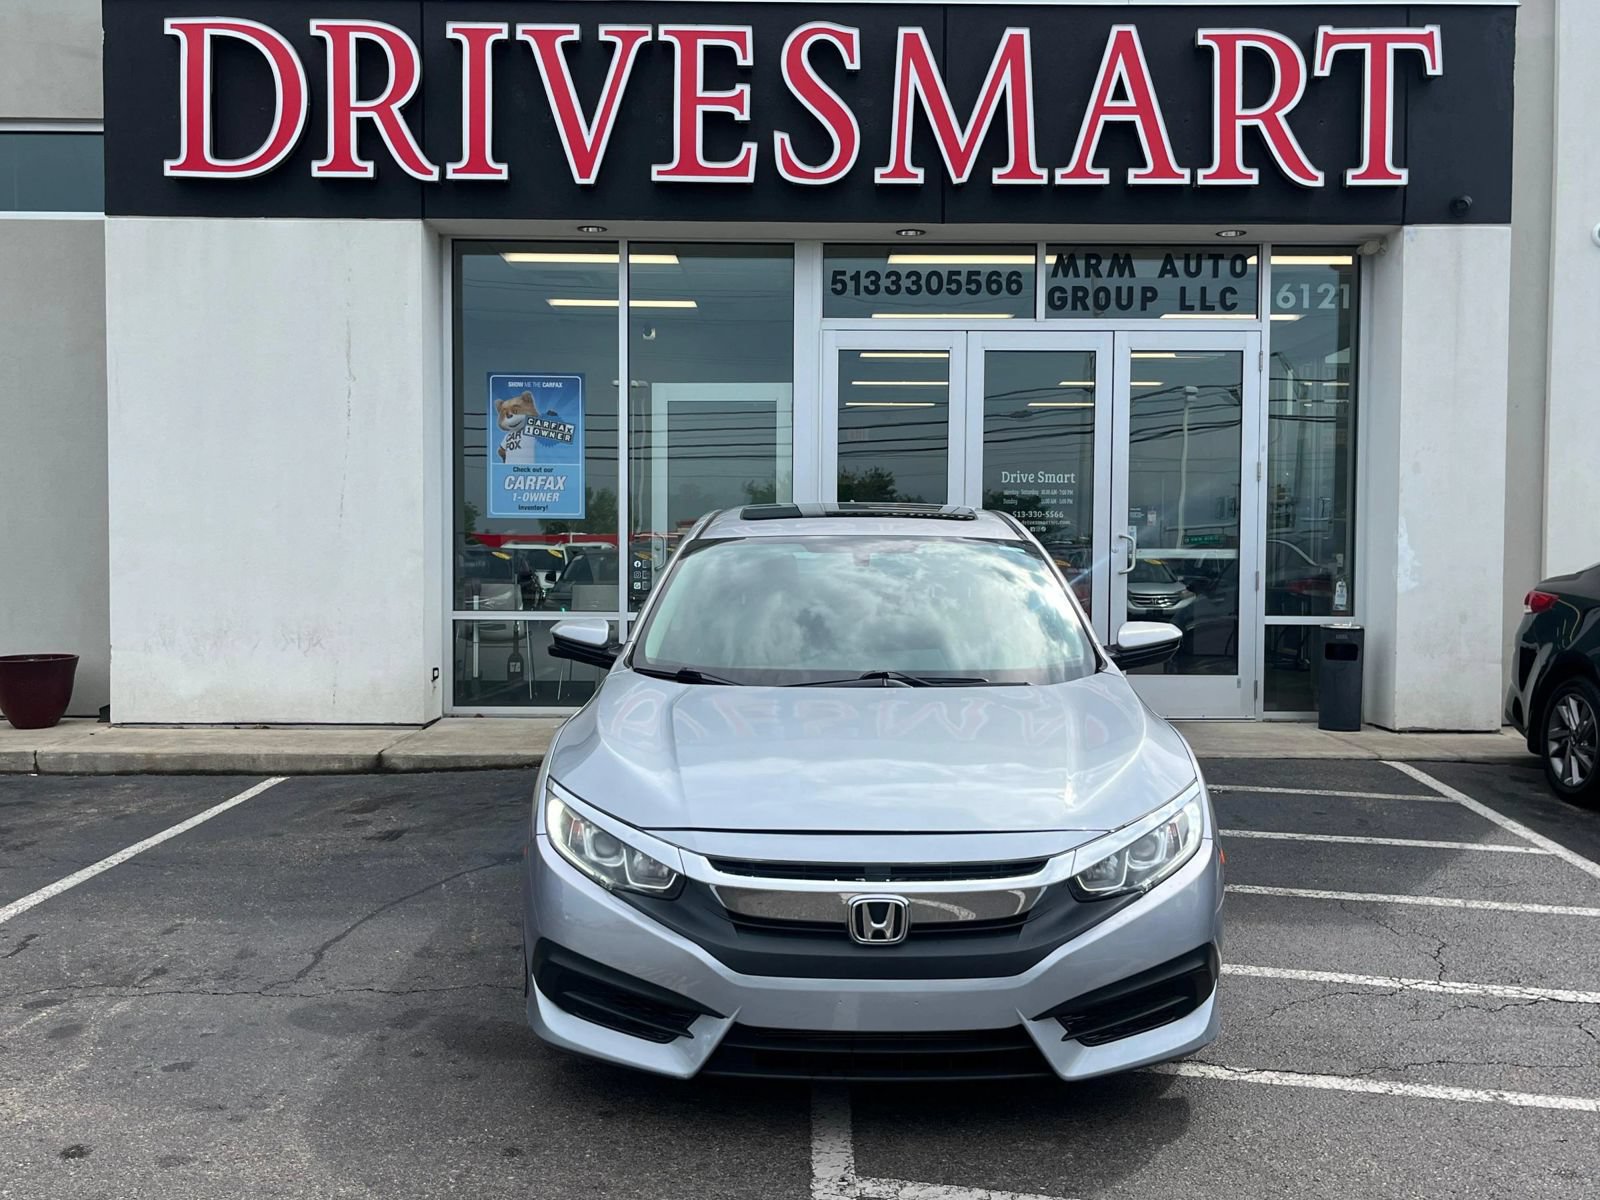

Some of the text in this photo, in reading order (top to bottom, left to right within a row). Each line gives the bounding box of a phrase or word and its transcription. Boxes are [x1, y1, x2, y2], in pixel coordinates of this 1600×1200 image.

[163, 16, 1443, 187] DRIVESMART
[1050, 252, 1248, 279] MRM AUTO
[830, 270, 1023, 296] 5133305566
[1047, 285, 1239, 312] GROUP LLC
[1275, 282, 1350, 310] 6121
[527, 417, 574, 434] CARFAX
[506, 440, 522, 450] FOX
[504, 475, 567, 490] CARFAX
[1001, 470, 1076, 484] Drive Smart
[512, 492, 560, 502] 1-OWNER
[518, 504, 549, 512] Inventory!
